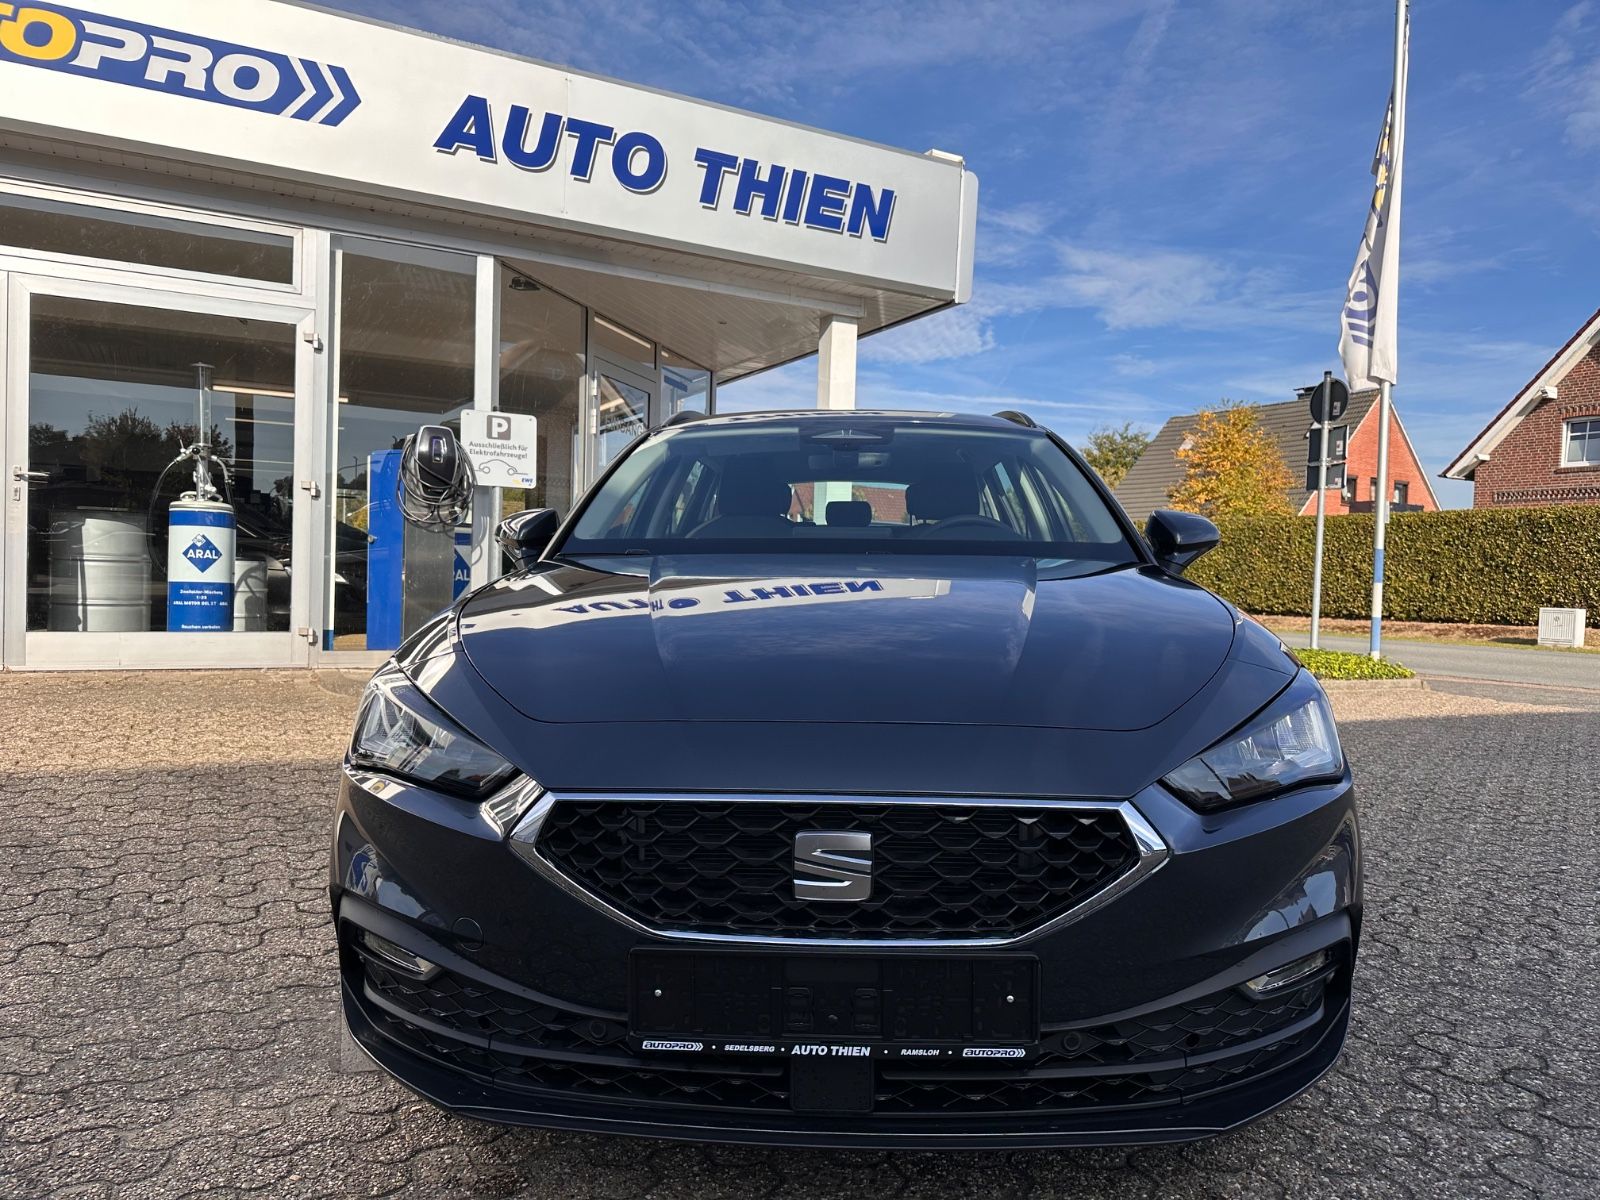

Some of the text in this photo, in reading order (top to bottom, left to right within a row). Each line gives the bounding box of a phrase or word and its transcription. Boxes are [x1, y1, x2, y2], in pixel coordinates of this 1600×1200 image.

[0, 2, 280, 102] OPRO
[432, 94, 896, 241] AUTO THIEN
[491, 417, 509, 438] P
[469, 441, 517, 451] Ausschließlich
[187, 549, 219, 559] ARAL
[724, 1044, 775, 1052] SEDELSBERG
[791, 1045, 828, 1055] AUTO
[831, 1046, 871, 1056] THIEN
